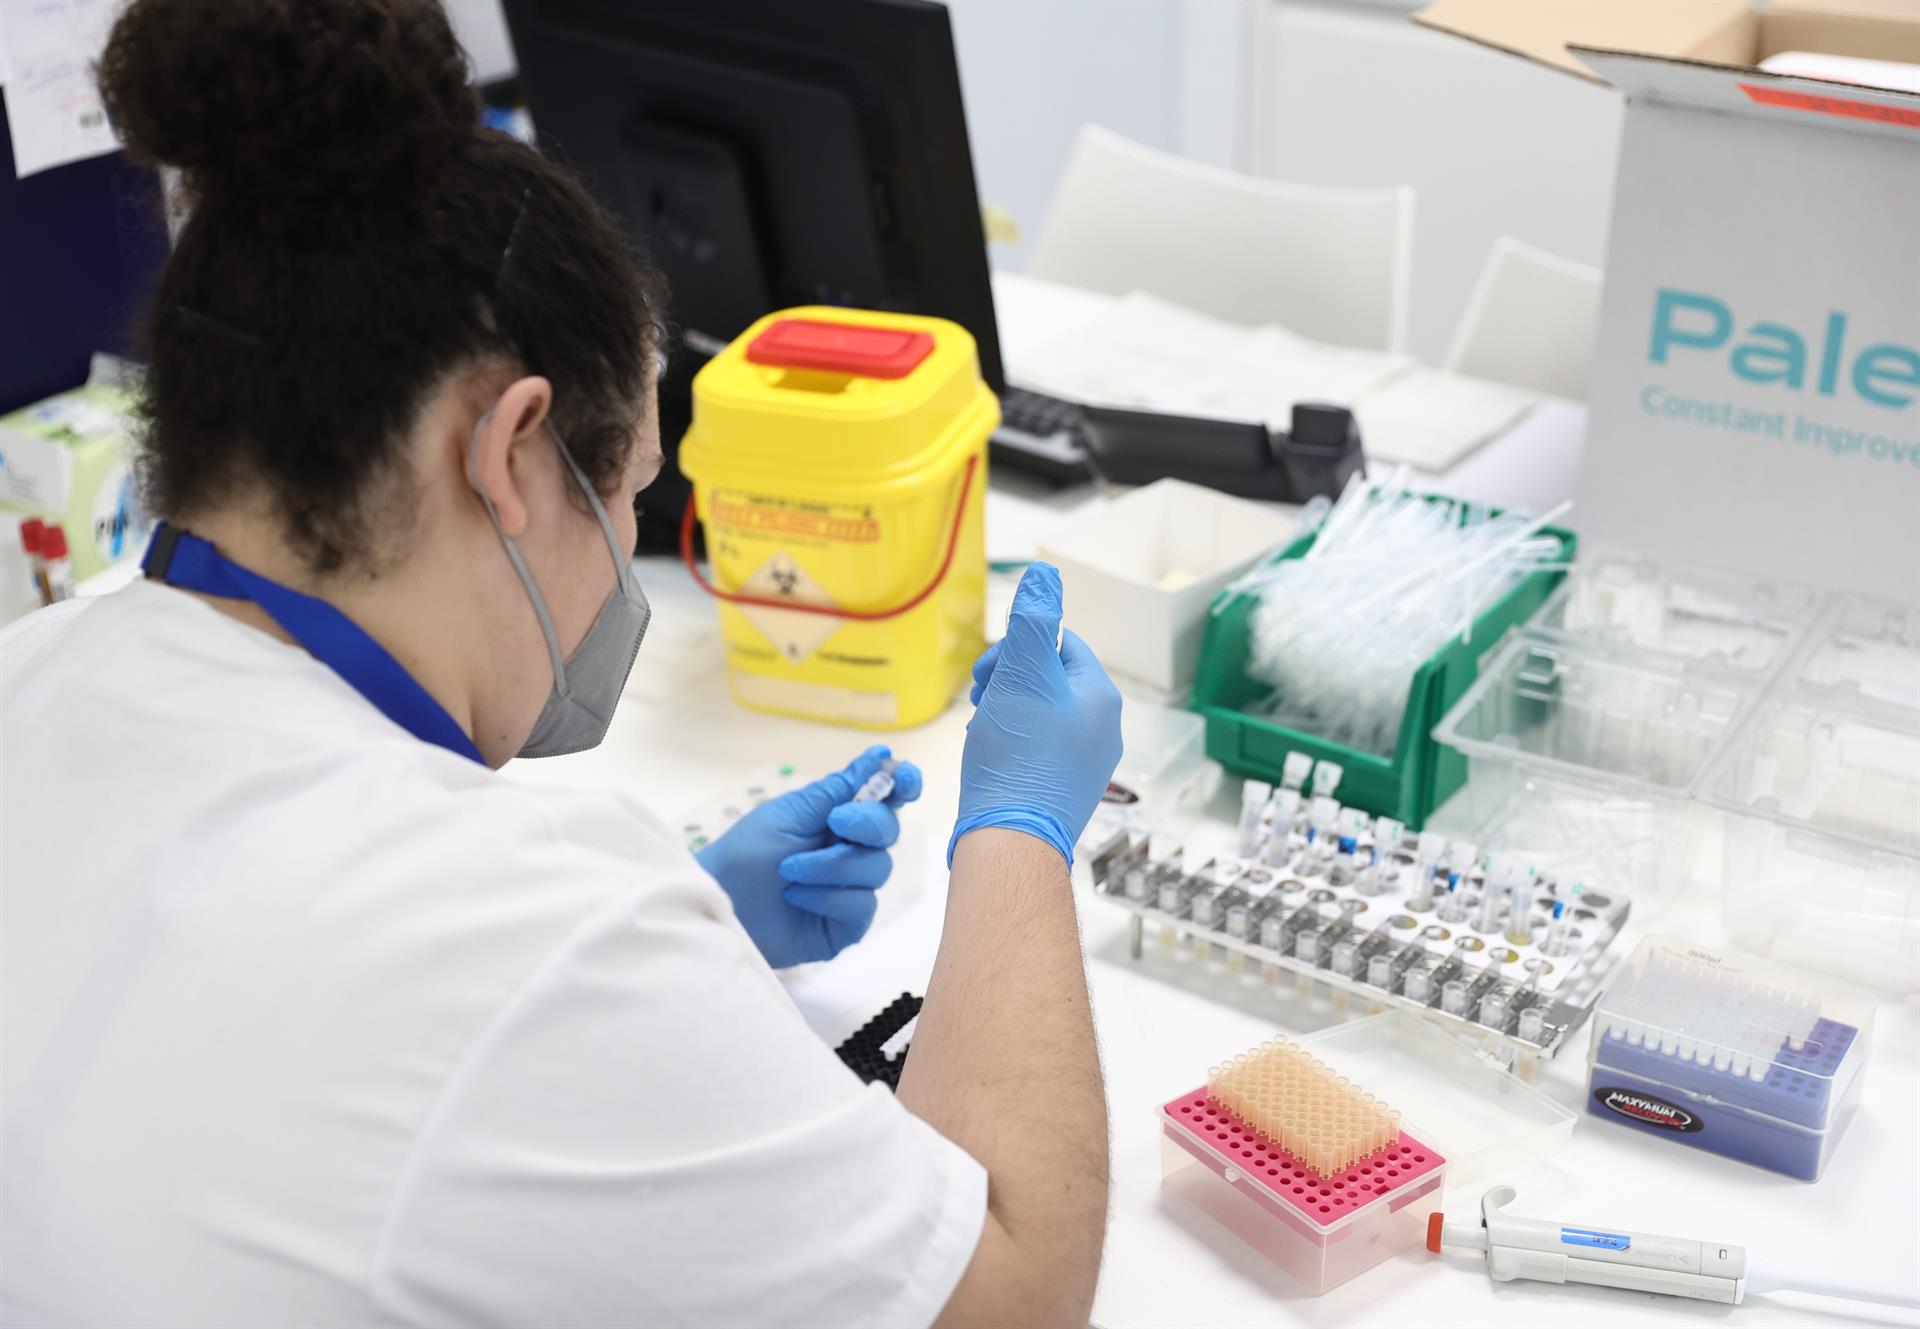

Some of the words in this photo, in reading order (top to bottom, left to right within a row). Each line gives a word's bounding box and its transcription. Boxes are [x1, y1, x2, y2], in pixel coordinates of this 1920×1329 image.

[1649, 286, 1920, 410] Pale
[1640, 385, 1786, 440] Constant
[1609, 1091, 1676, 1118] MAXYMUM
